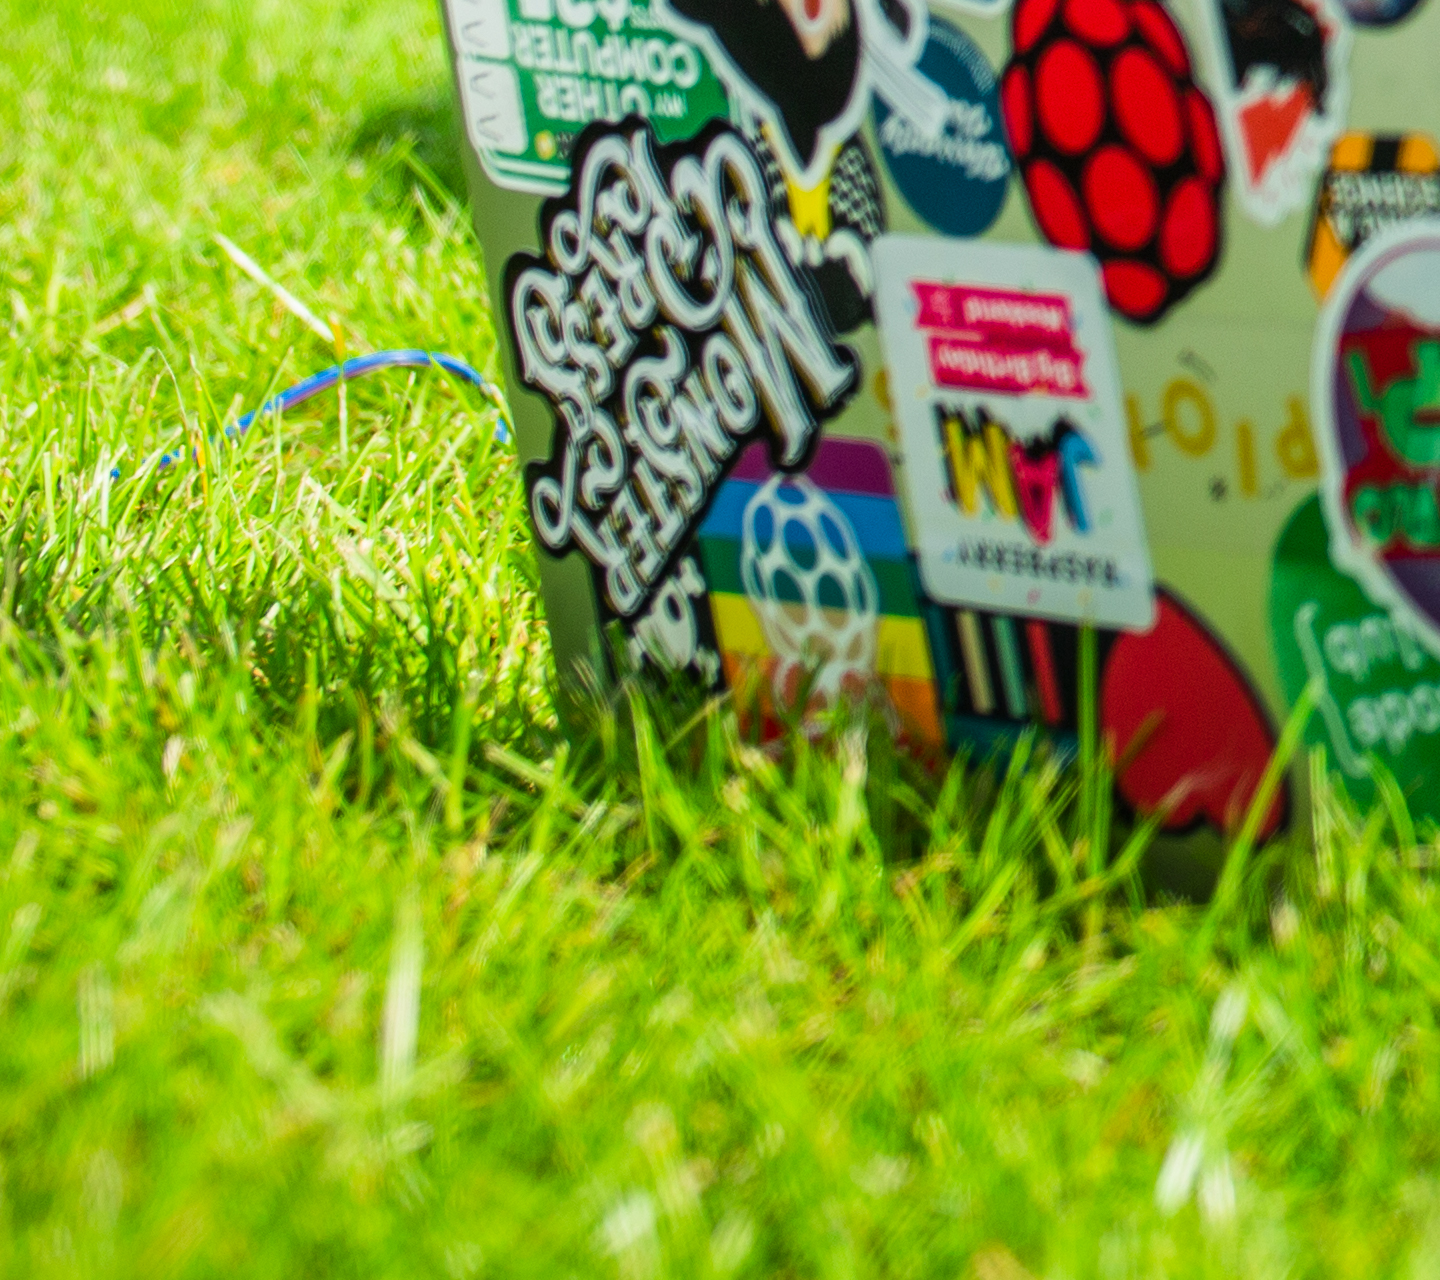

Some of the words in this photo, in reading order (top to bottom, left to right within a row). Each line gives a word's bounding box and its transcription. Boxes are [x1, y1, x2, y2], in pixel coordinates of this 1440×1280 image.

[511, 21, 700, 90] COMPUTER
[533, 73, 649, 123] OTHER
[508, 132, 735, 460] PRESS
[532, 240, 855, 616] MONSTER
[936, 408, 1100, 548] JAM
[955, 534, 1118, 592] RASPBERRY
[1323, 614, 1424, 682] lub
